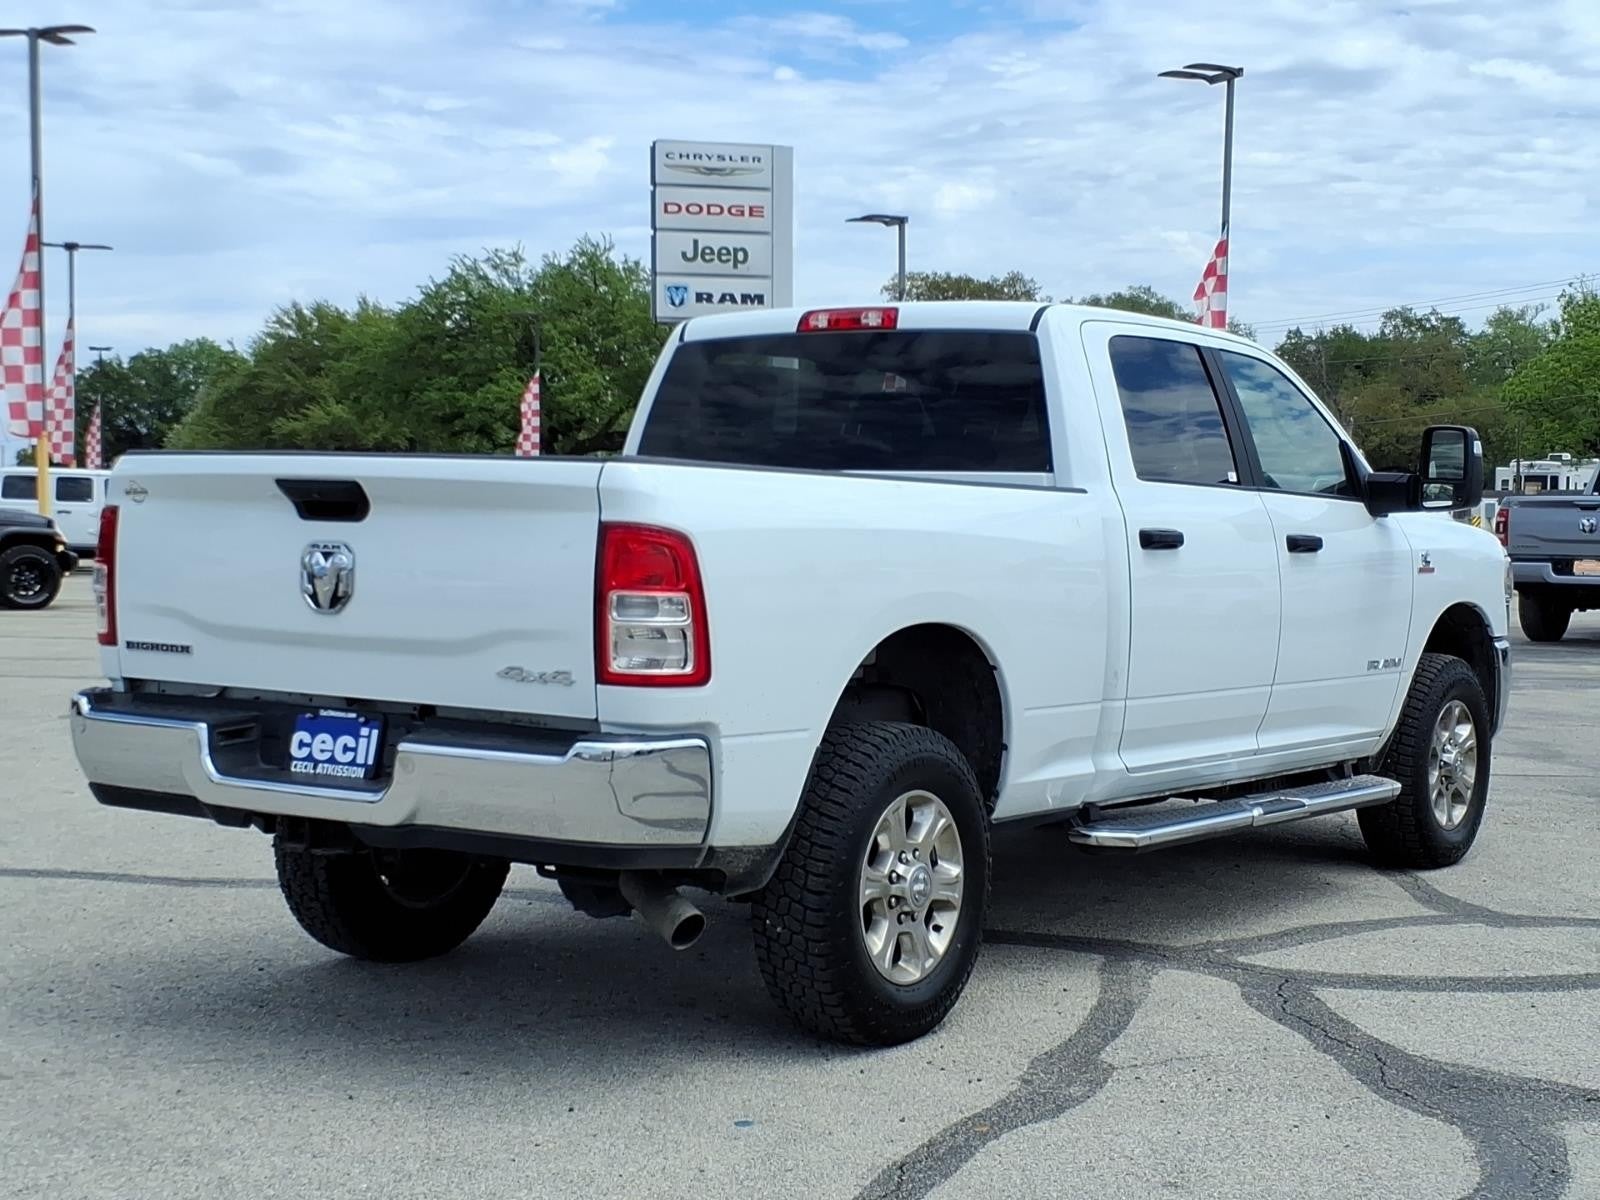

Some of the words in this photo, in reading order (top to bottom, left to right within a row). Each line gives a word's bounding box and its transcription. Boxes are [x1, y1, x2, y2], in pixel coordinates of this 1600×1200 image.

[665, 152, 762, 163] CHRYSLER
[663, 202, 765, 218] DODGE
[681, 238, 749, 269] Jeep
[695, 292, 765, 305] RAM
[289, 727, 379, 765] cecil
[290, 761, 315, 774] CECIL
[316, 763, 365, 778] ATKISSION
